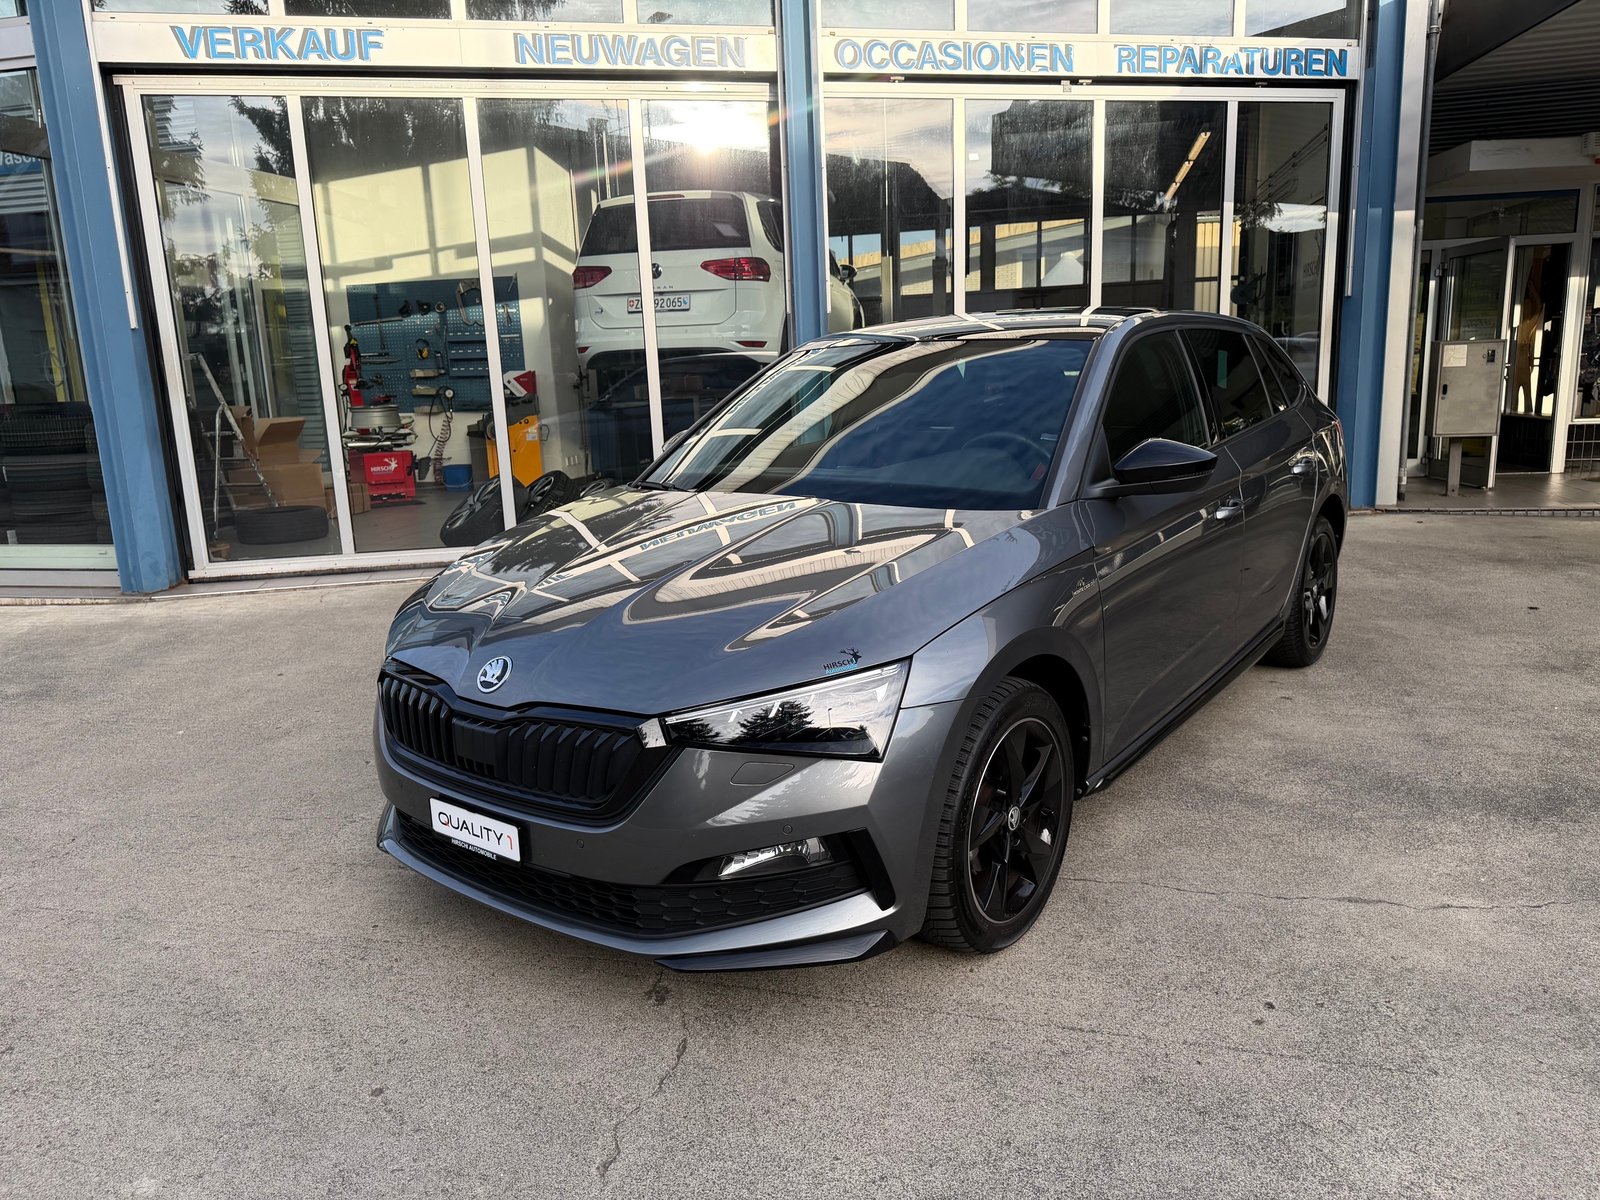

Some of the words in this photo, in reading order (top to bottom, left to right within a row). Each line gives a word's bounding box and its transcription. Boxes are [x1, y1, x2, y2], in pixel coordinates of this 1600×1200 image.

[169, 25, 385, 62] VERKAUF
[513, 32, 746, 68] NEUWAGEN
[834, 38, 1074, 73] OCCASIONEN
[1114, 44, 1348, 77] REPARATUREN
[438, 811, 504, 846] QUALITY
[506, 834, 513, 851] 1
